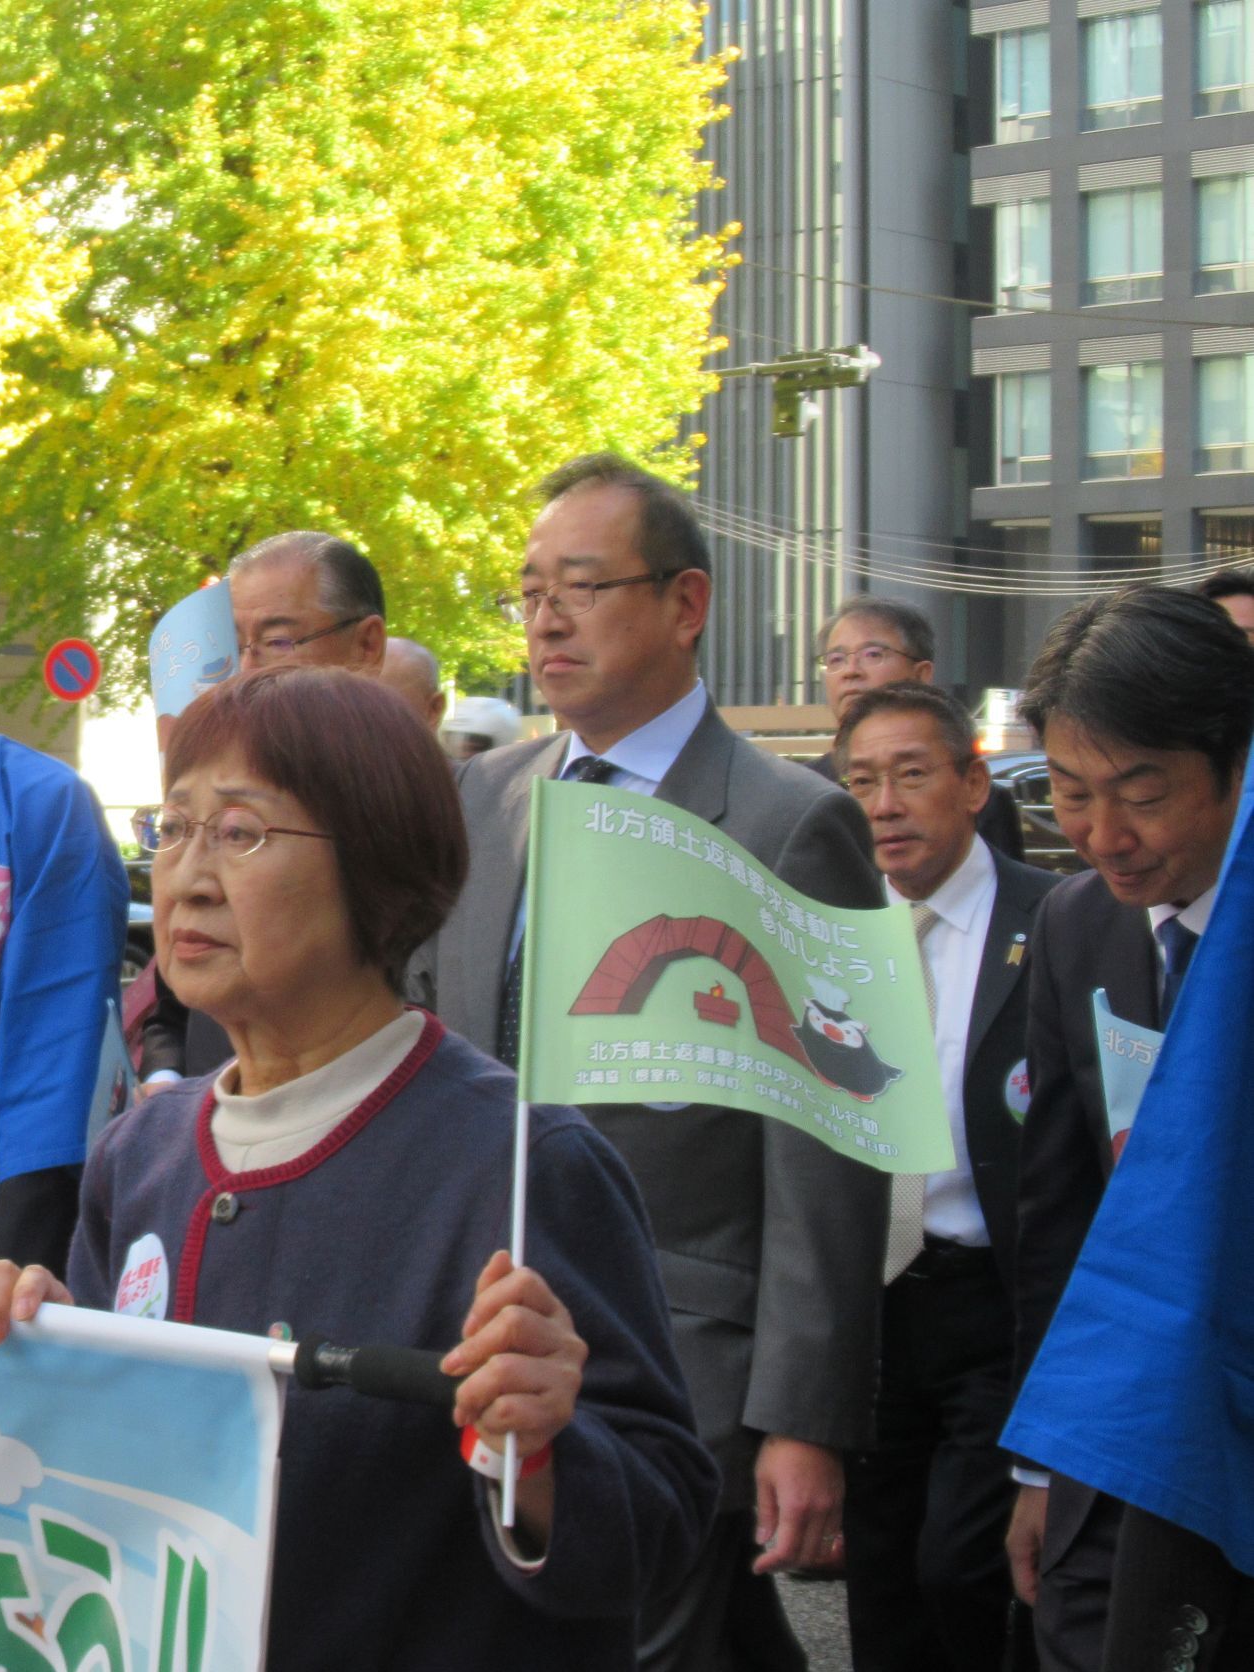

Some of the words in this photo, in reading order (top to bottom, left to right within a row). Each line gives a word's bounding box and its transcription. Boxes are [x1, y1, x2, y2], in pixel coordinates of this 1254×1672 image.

[585, 801, 861, 949] 北方領土返還要求運動に
[759, 907, 897, 984] 参加しよう！
[1105, 1028, 1162, 1066] 北方
